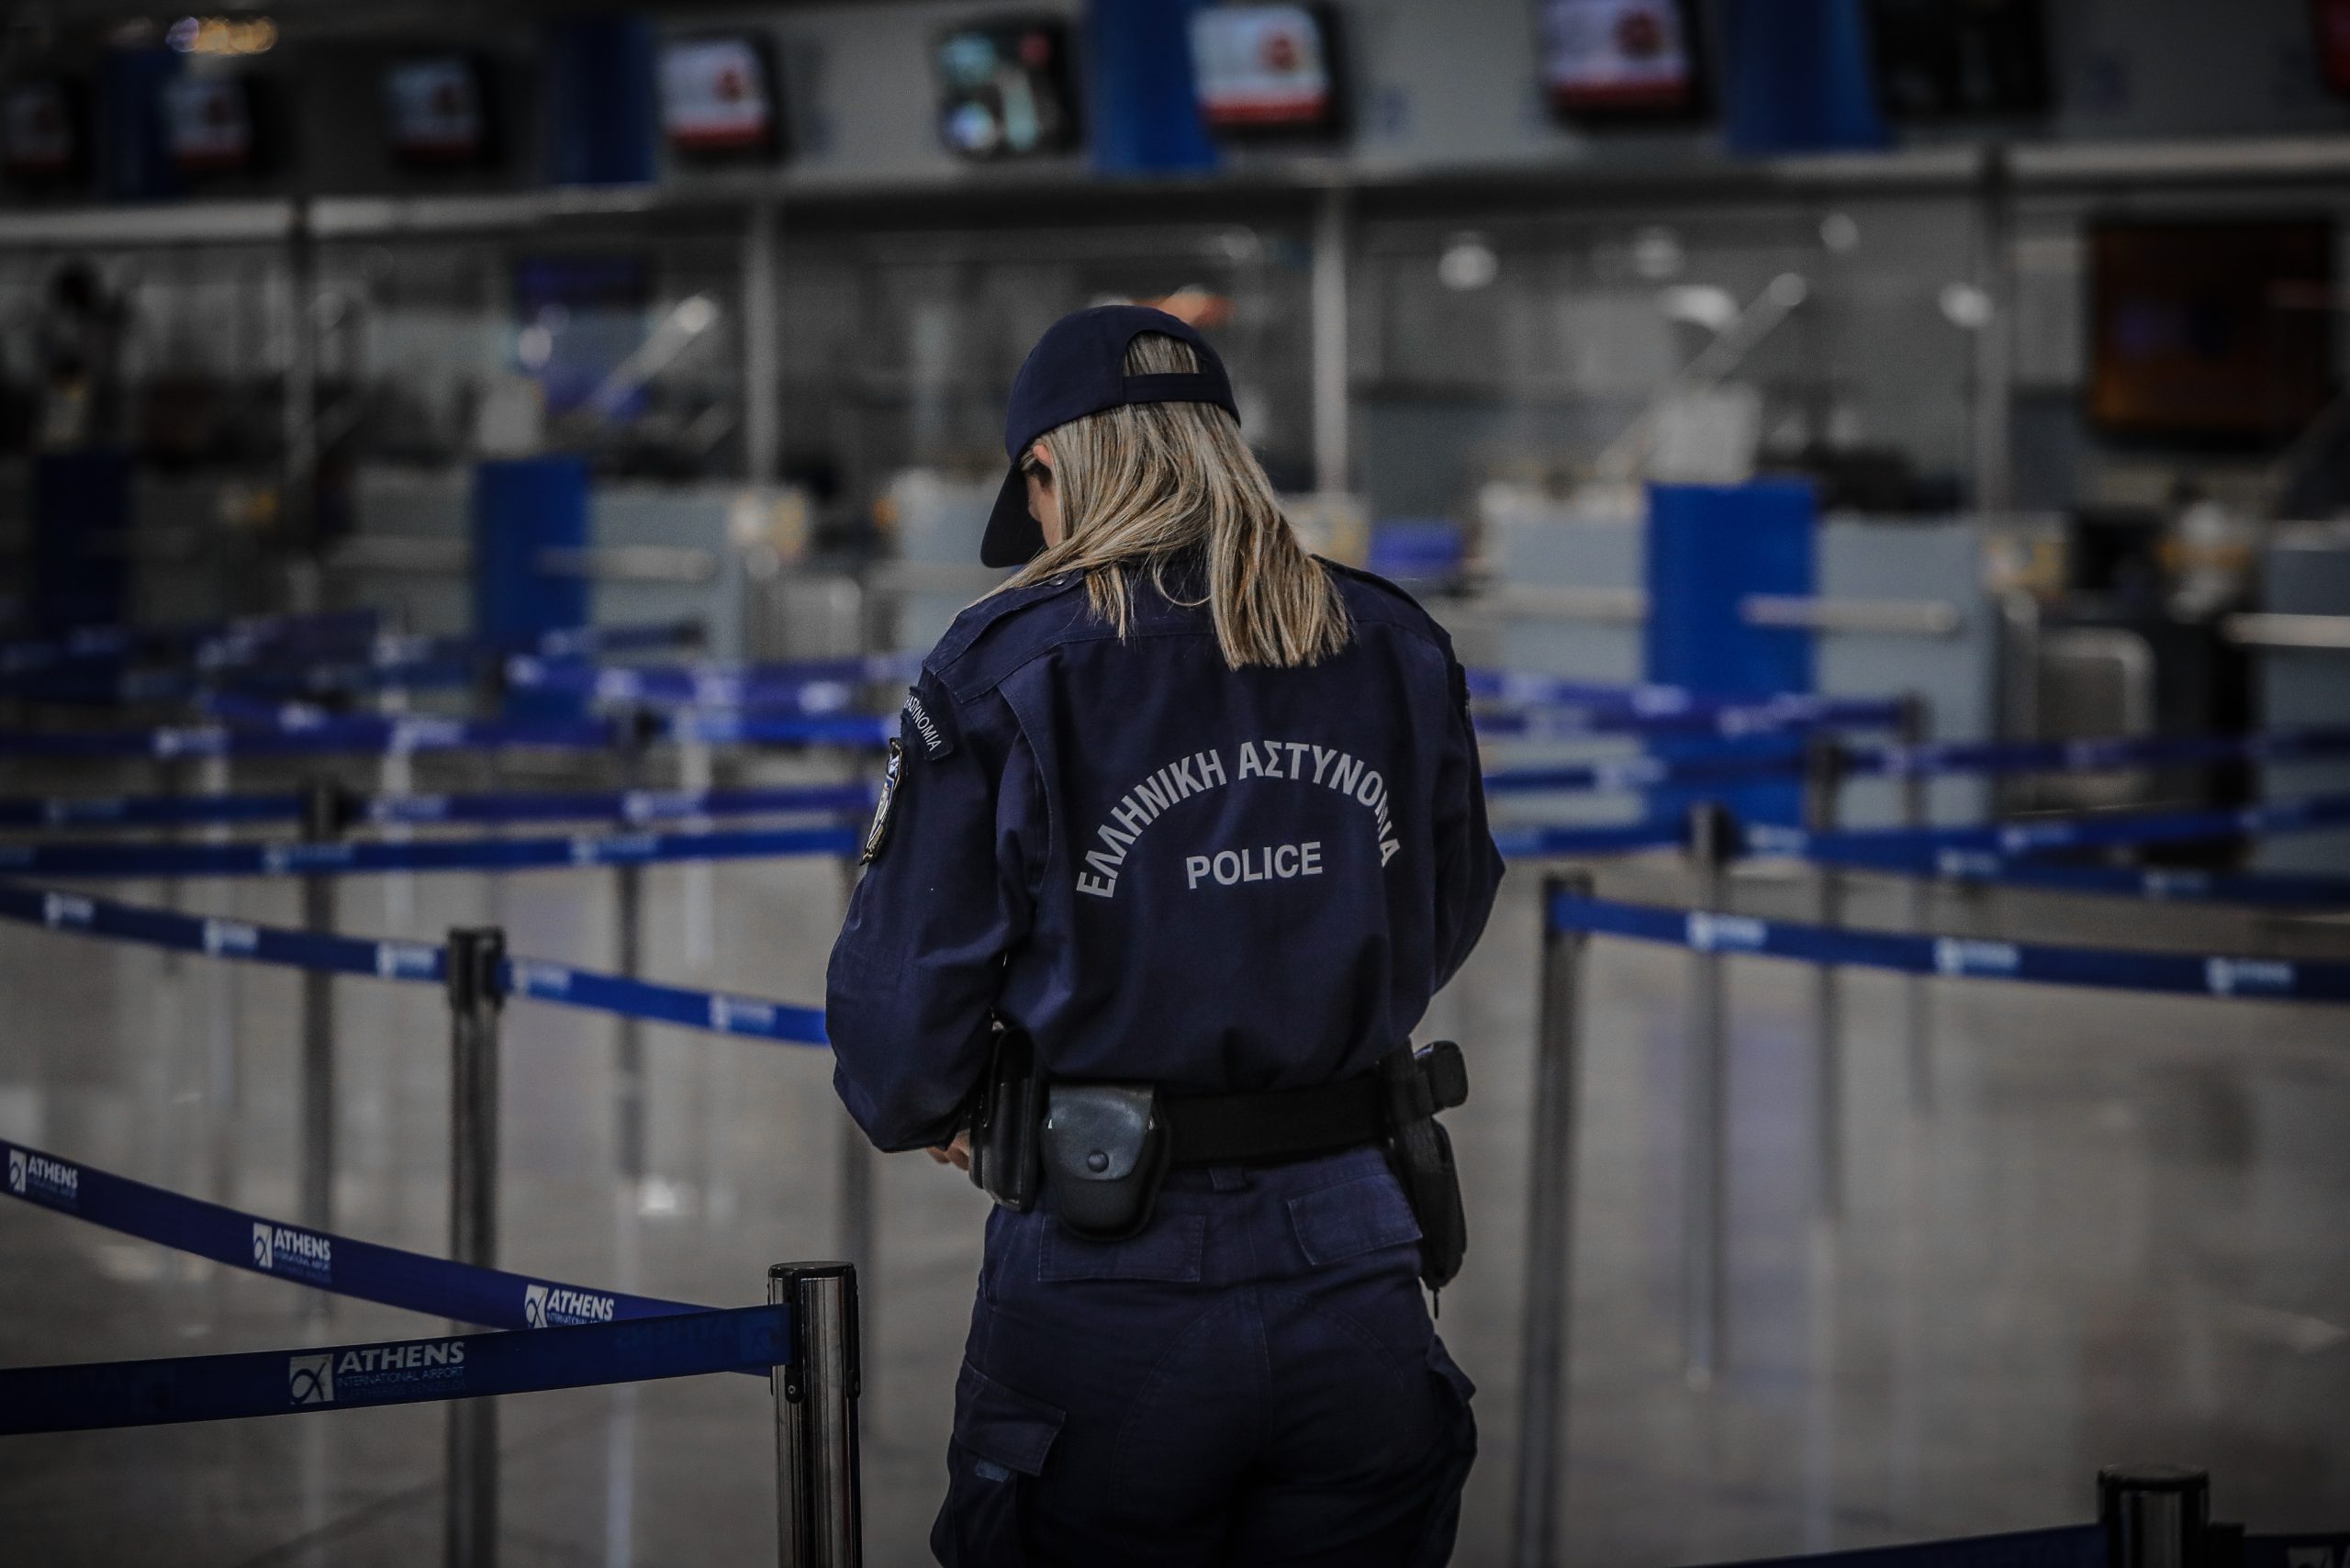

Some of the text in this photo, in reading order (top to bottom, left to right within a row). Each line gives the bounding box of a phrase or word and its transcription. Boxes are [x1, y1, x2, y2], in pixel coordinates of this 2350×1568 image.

[1076, 740, 1401, 899] ΕΛΛΗΝΙΚΗ ΑΣΤΥΝΟΜΙΑ
[1185, 841, 1323, 890] POLICE
[28, 1155, 79, 1190] ATHENS
[274, 1226, 331, 1261] ATHENS
[547, 1288, 615, 1322] ATHENS
[337, 1341, 465, 1374] ATHENS
[337, 1365, 465, 1389] INTERNATIONAL AIRPORT
